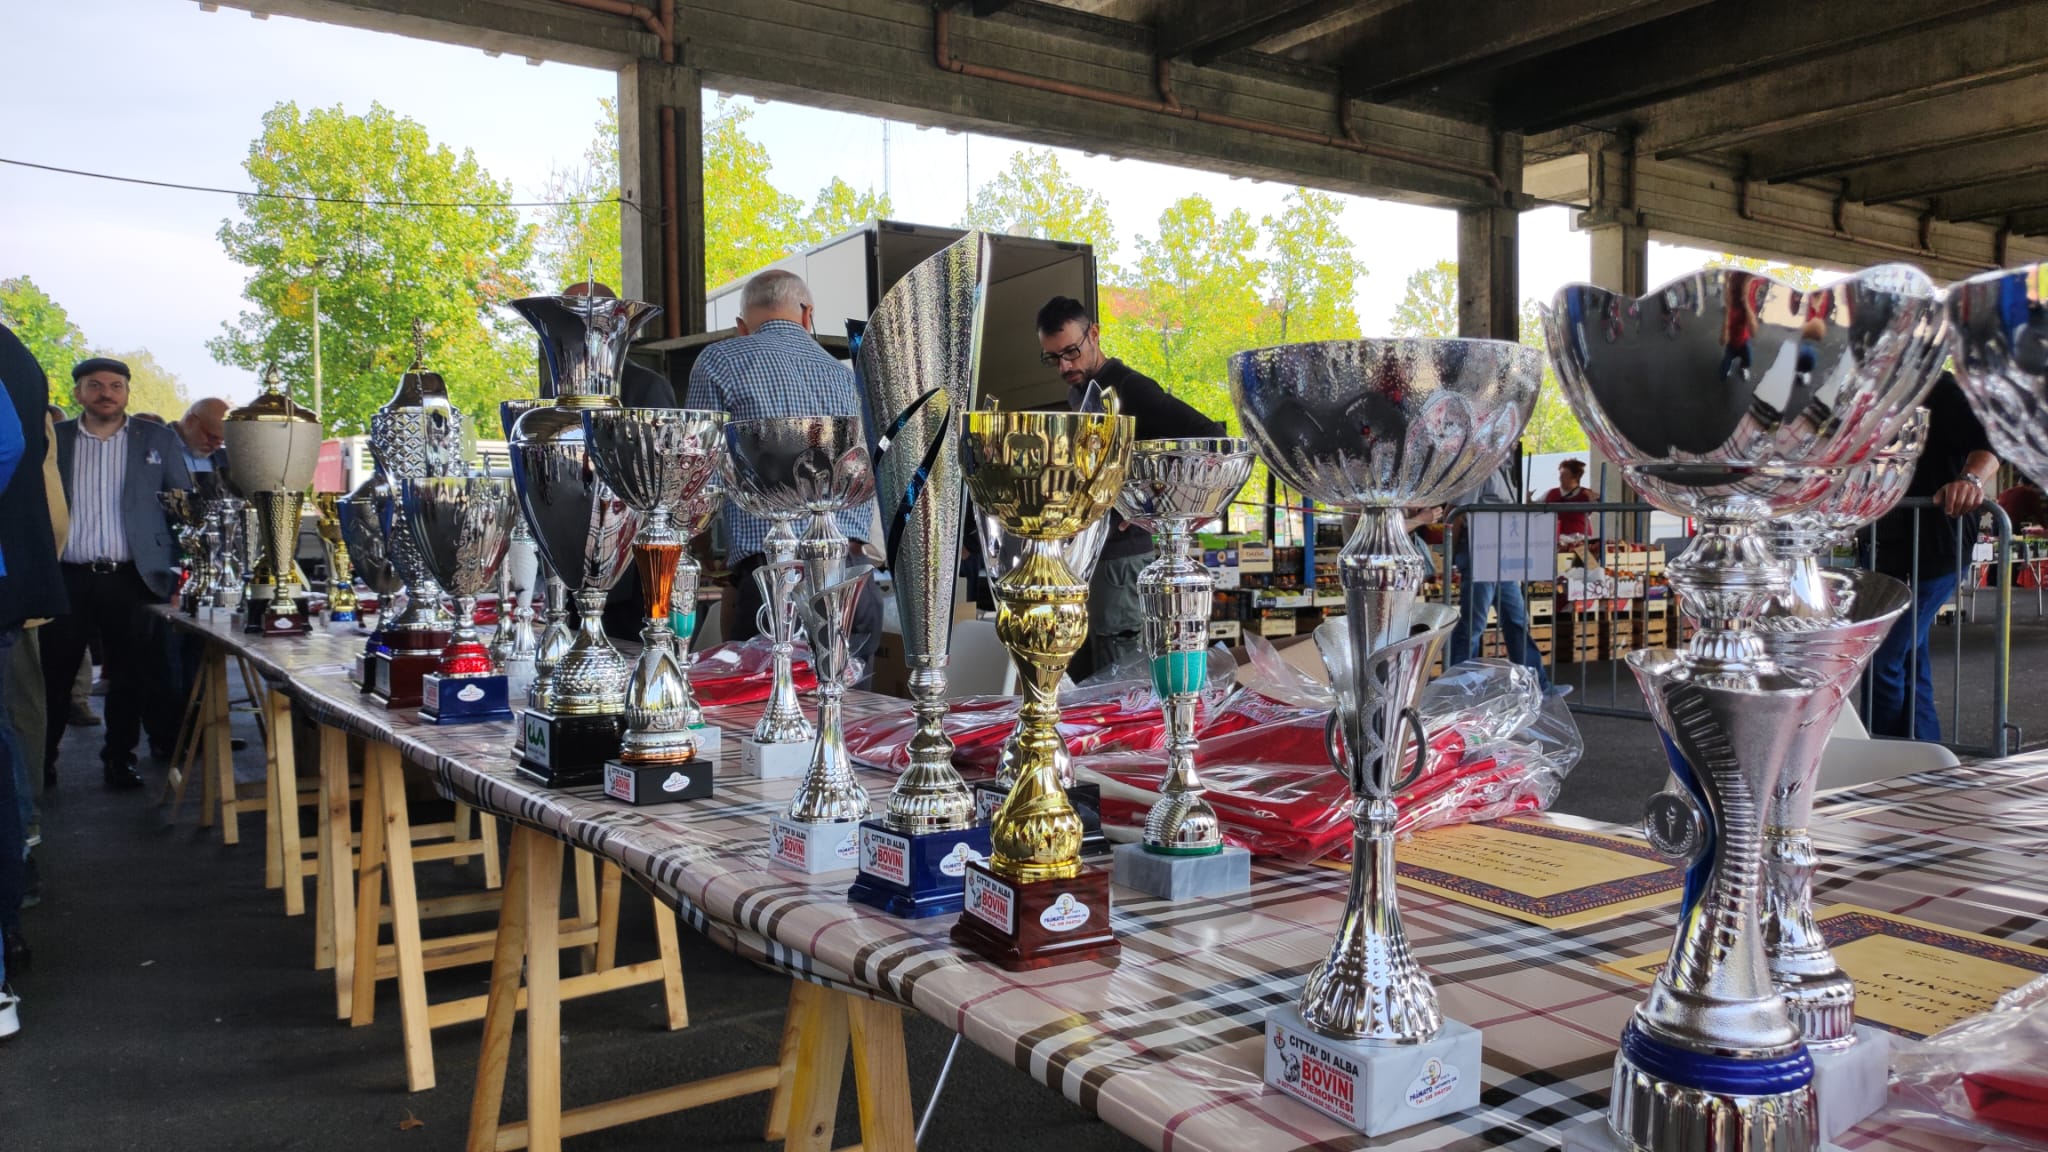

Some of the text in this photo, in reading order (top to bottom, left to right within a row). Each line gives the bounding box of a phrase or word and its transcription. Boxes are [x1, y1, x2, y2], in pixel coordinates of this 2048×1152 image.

[784, 838, 805, 856] BOVINI
[878, 848, 903, 869] BOVINI
[982, 891, 1008, 918] BOVINI
[1882, 972, 1999, 1005] PREMIO
[1289, 1035, 1359, 1077] CITTA' DI ALBA
[1301, 1080, 1353, 1114] PIEMONTESI
[1302, 1060, 1353, 1103] BOVINI
